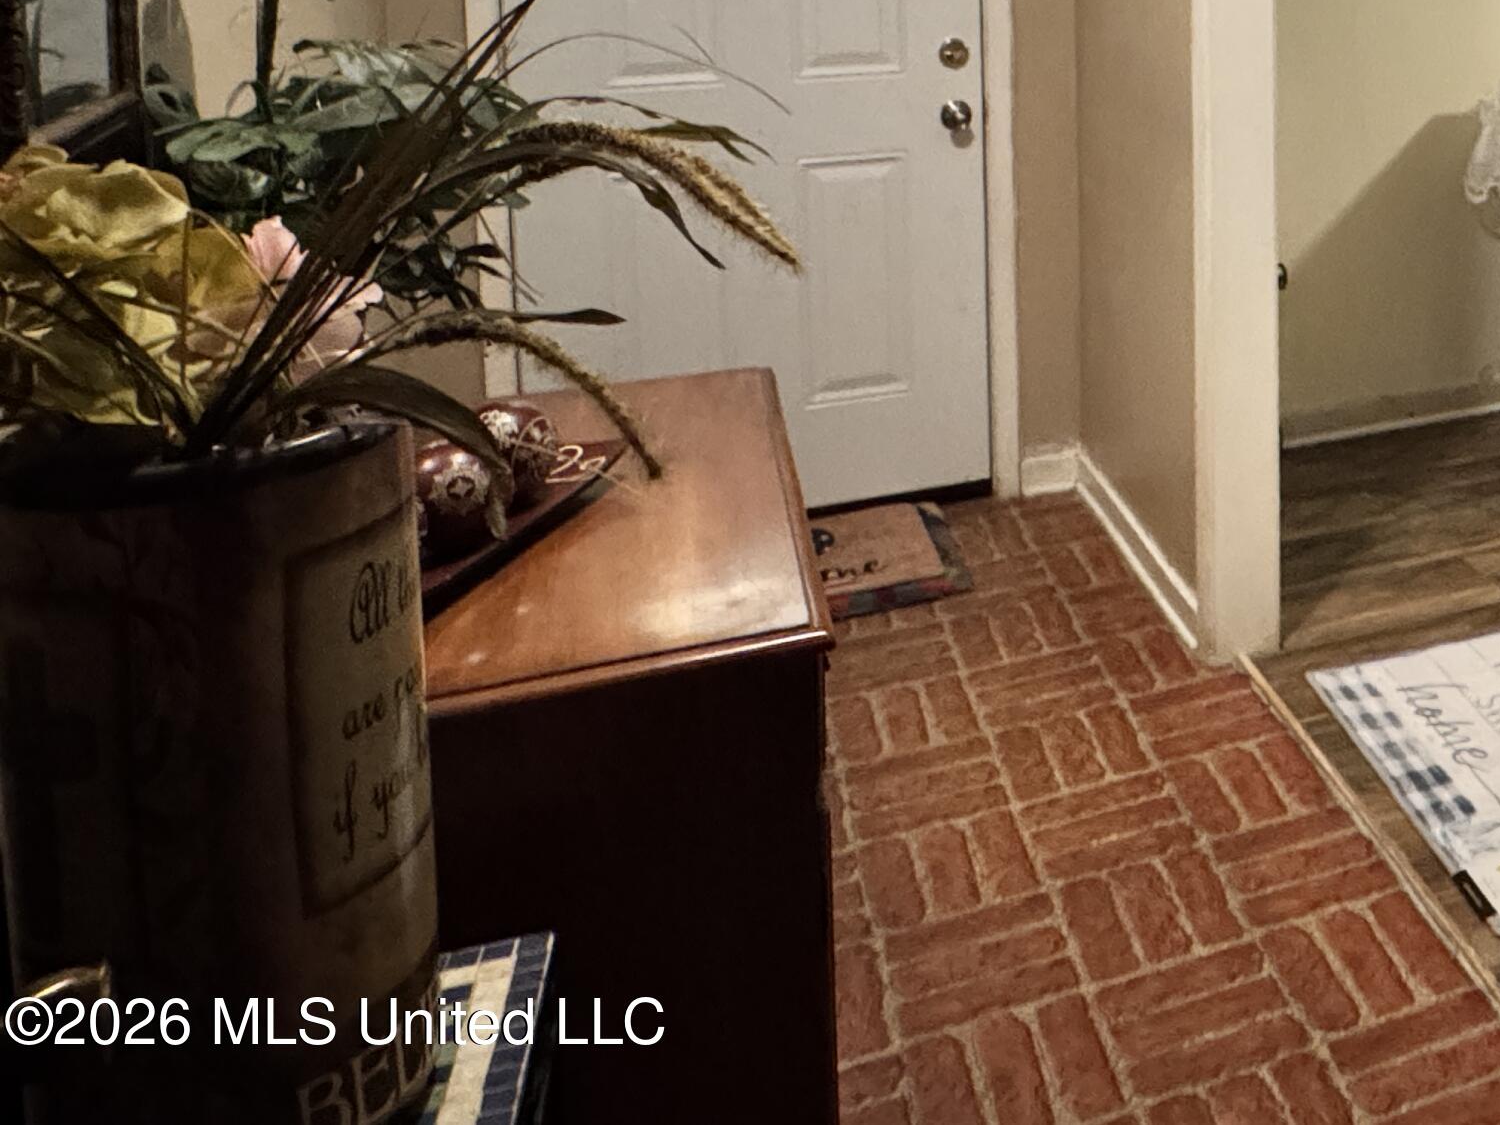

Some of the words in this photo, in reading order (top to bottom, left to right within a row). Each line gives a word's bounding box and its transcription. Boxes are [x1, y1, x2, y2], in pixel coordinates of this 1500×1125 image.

[341, 693, 387, 741] are
[1396, 683, 1490, 773] home
[333, 759, 359, 863] if
